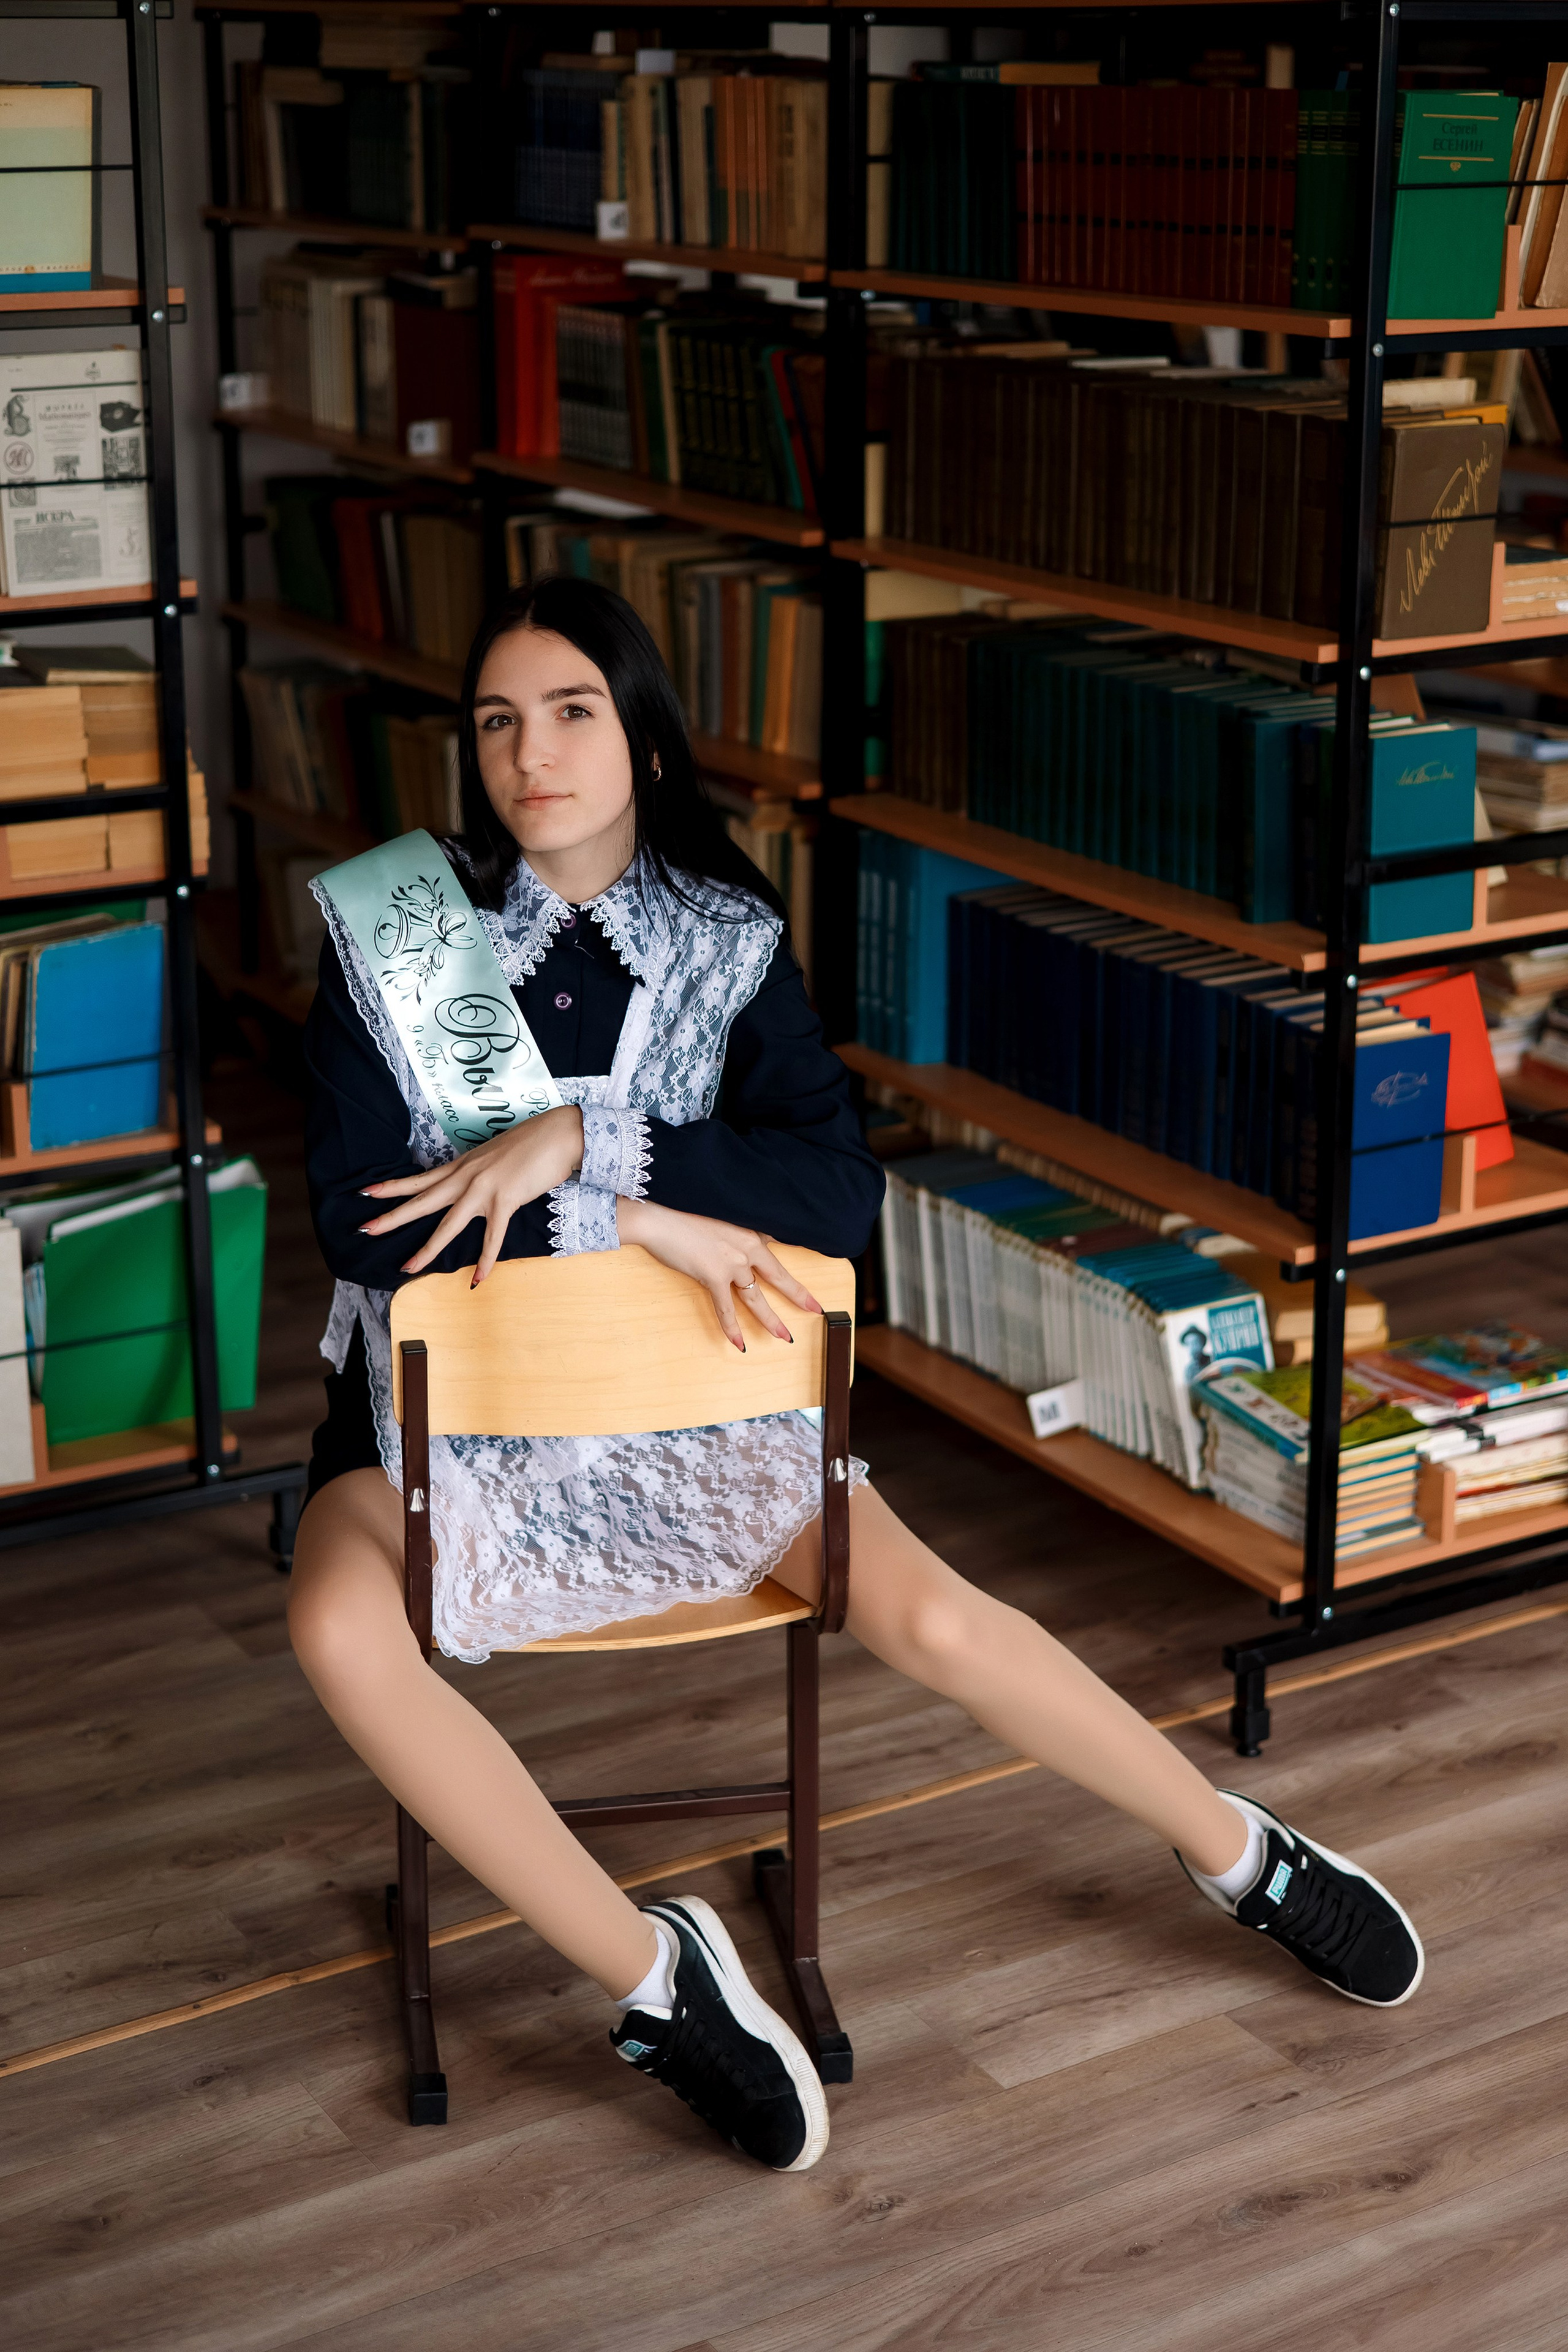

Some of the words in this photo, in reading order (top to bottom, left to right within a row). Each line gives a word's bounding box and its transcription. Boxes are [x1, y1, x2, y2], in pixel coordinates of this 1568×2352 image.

[1441, 121, 1478, 137] Сергей
[1433, 138, 1484, 153] ЕСЕНИН
[432, 1082, 459, 1123] класс
[1272, 1868, 1288, 1896] PUMA
